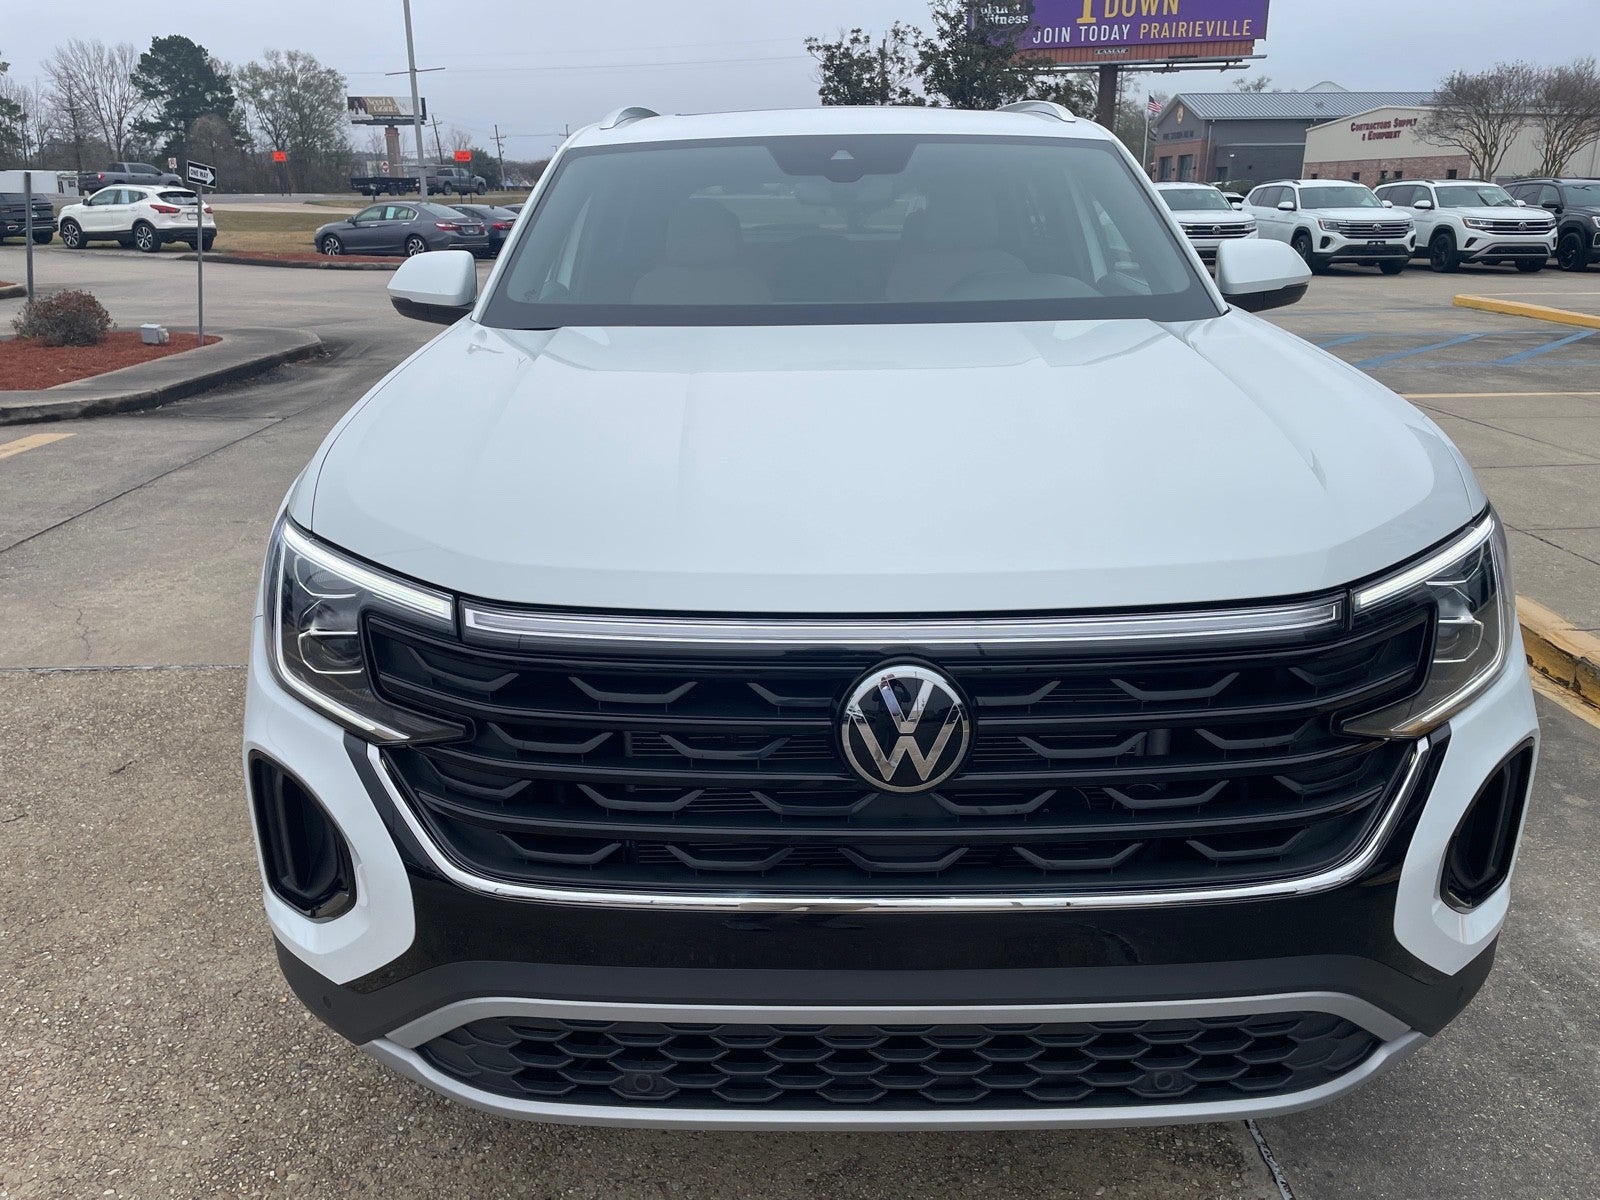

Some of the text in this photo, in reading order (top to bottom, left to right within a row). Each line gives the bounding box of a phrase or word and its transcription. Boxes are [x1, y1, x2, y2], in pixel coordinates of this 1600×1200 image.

[984, 14, 1029, 25] itness
[1032, 19, 1253, 44] JOIN TODAY PRAIRIEVILLE
[1096, 47, 1127, 55] LAMAR
